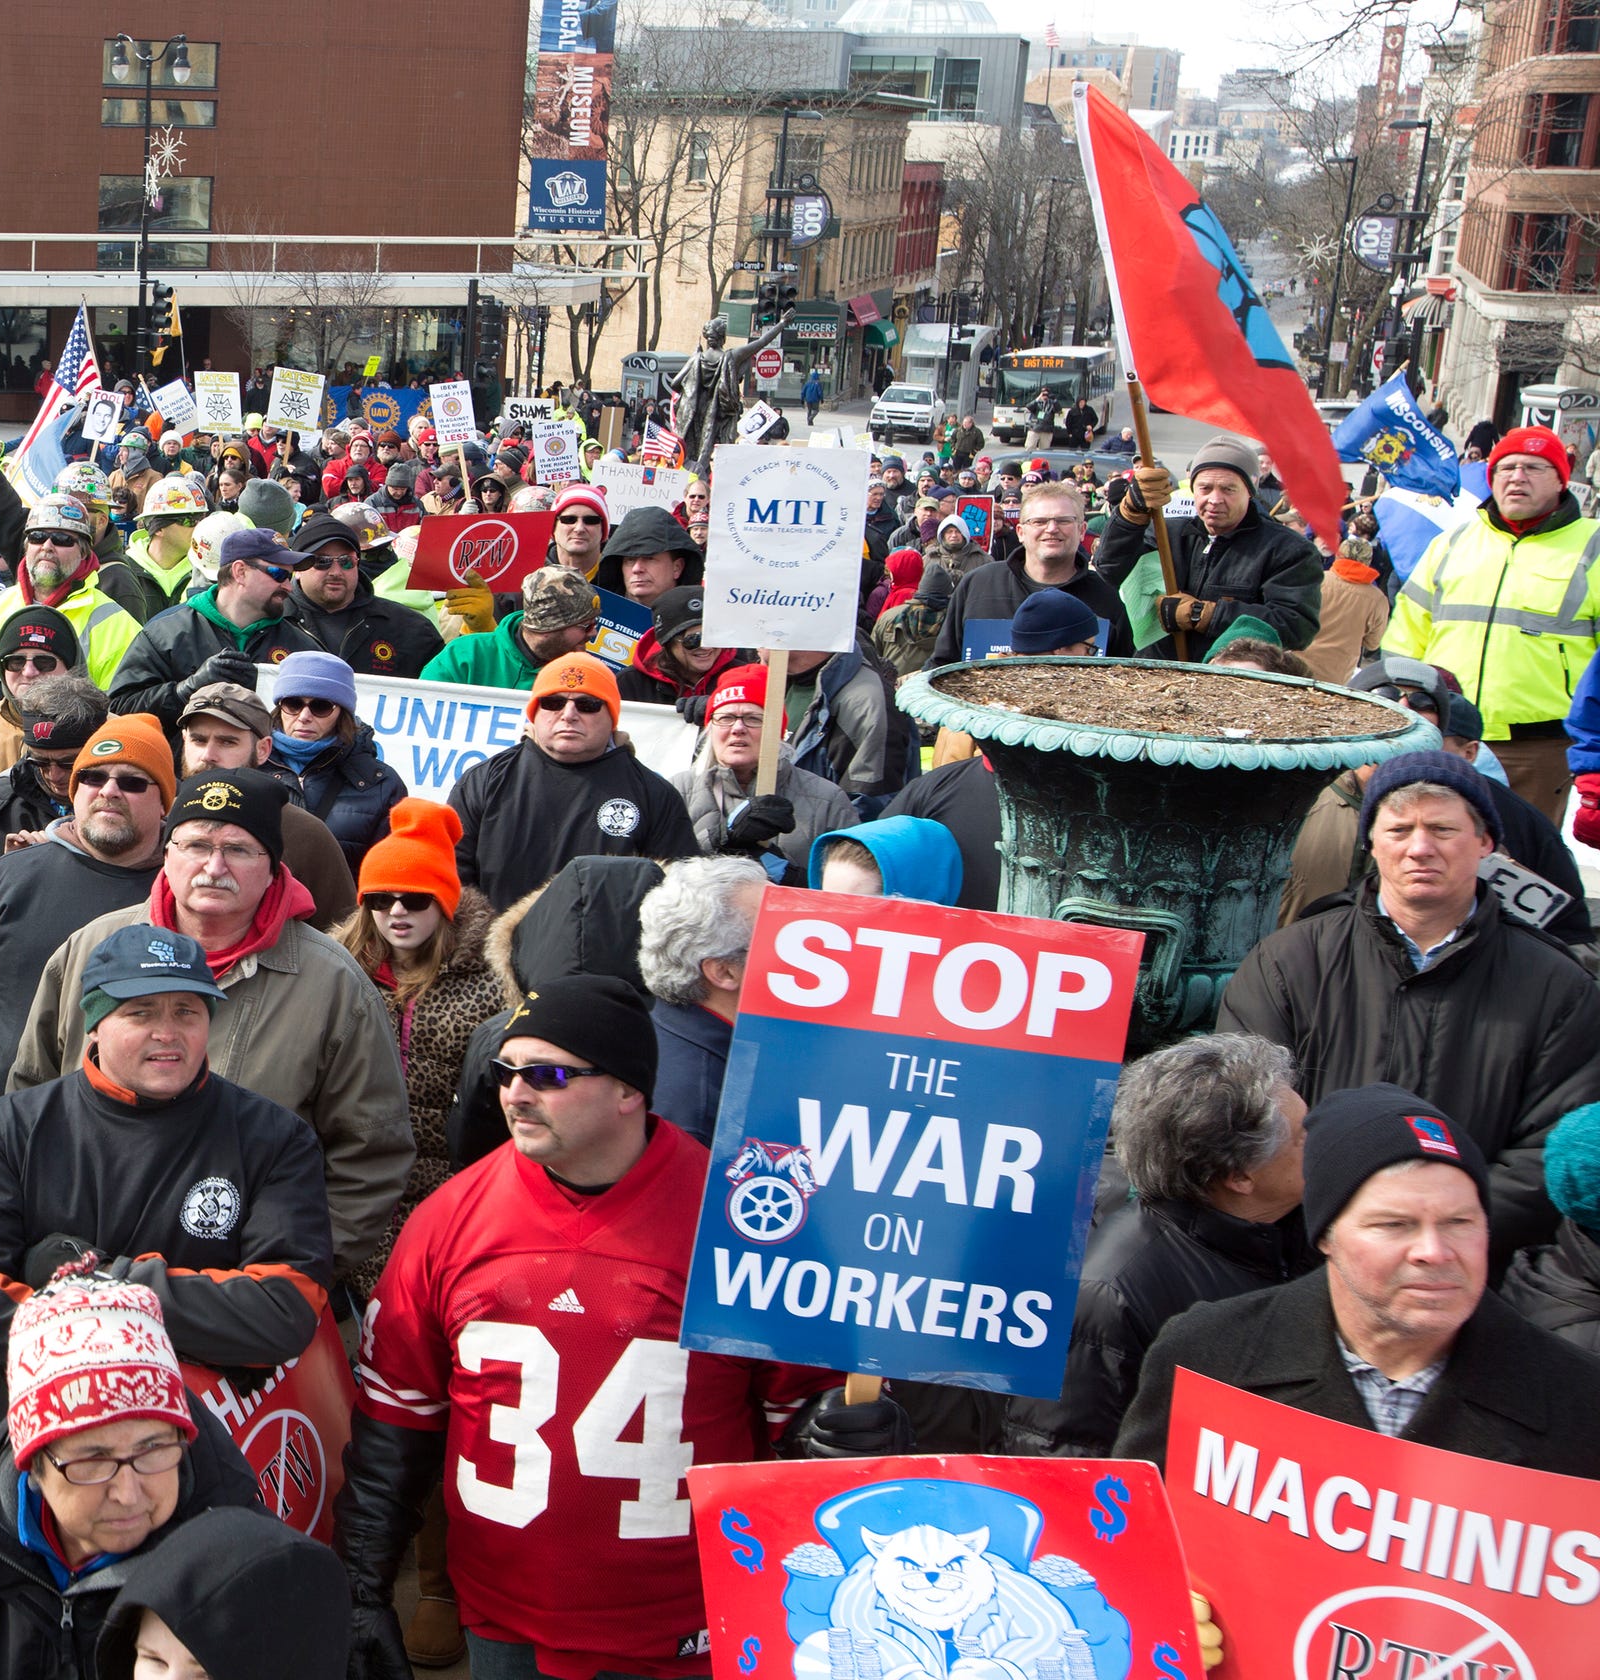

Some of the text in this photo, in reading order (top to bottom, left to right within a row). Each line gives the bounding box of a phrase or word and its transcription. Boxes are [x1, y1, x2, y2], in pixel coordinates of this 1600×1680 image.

[569, 66, 594, 147] MUSEUM
[532, 206, 602, 215] Wisconsin Historical
[538, 216, 596, 224] MUSEUM
[792, 203, 805, 237] BLOCK
[804, 198, 824, 237] 100
[1357, 218, 1383, 258] 100
[1377, 226, 1394, 261] BLOCK
[760, 366, 778, 374] ENTER
[1012, 358, 1018, 368] 3
[1024, 358, 1040, 368] EAST
[199, 373, 235, 383] IATSE
[279, 368, 319, 385] IATSE
[432, 391, 452, 399] Local
[440, 383, 459, 391] IBEW
[93, 390, 122, 405] TOOL
[371, 407, 390, 417] UAW
[510, 403, 552, 419] SHAME
[757, 405, 774, 424] TOOL
[1385, 388, 1455, 462] WISCONSIN
[444, 433, 469, 442] LESS
[534, 431, 552, 439] Local
[550, 455, 573, 463] AGAINST
[554, 461, 572, 469] RIGHT
[545, 471, 572, 482] LESS
[600, 465, 679, 484] THANK THE
[739, 460, 840, 491] WE TEACH THE CHILDREN
[616, 484, 670, 500] UNION
[745, 498, 828, 526] MTI
[726, 502, 848, 569] COLLECTIVELY WE DECIDE UNITED WE ACT
[457, 538, 513, 571] RTW
[727, 587, 835, 611] Solidarity!
[19, 625, 56, 639] IBEW
[713, 686, 746, 708] MTI
[374, 693, 529, 747] UNITE
[32, 721, 55, 740] W
[91, 740, 123, 756] G
[196, 781, 244, 798] TEAMSTERS
[767, 919, 1113, 1037] STOP
[885, 1051, 961, 1098] THE
[798, 1097, 1044, 1214] WAR
[863, 1213, 924, 1256] ON
[549, 1298, 585, 1314] adidas
[714, 1247, 1053, 1350] WORKERS
[457, 1320, 694, 1539] 34
